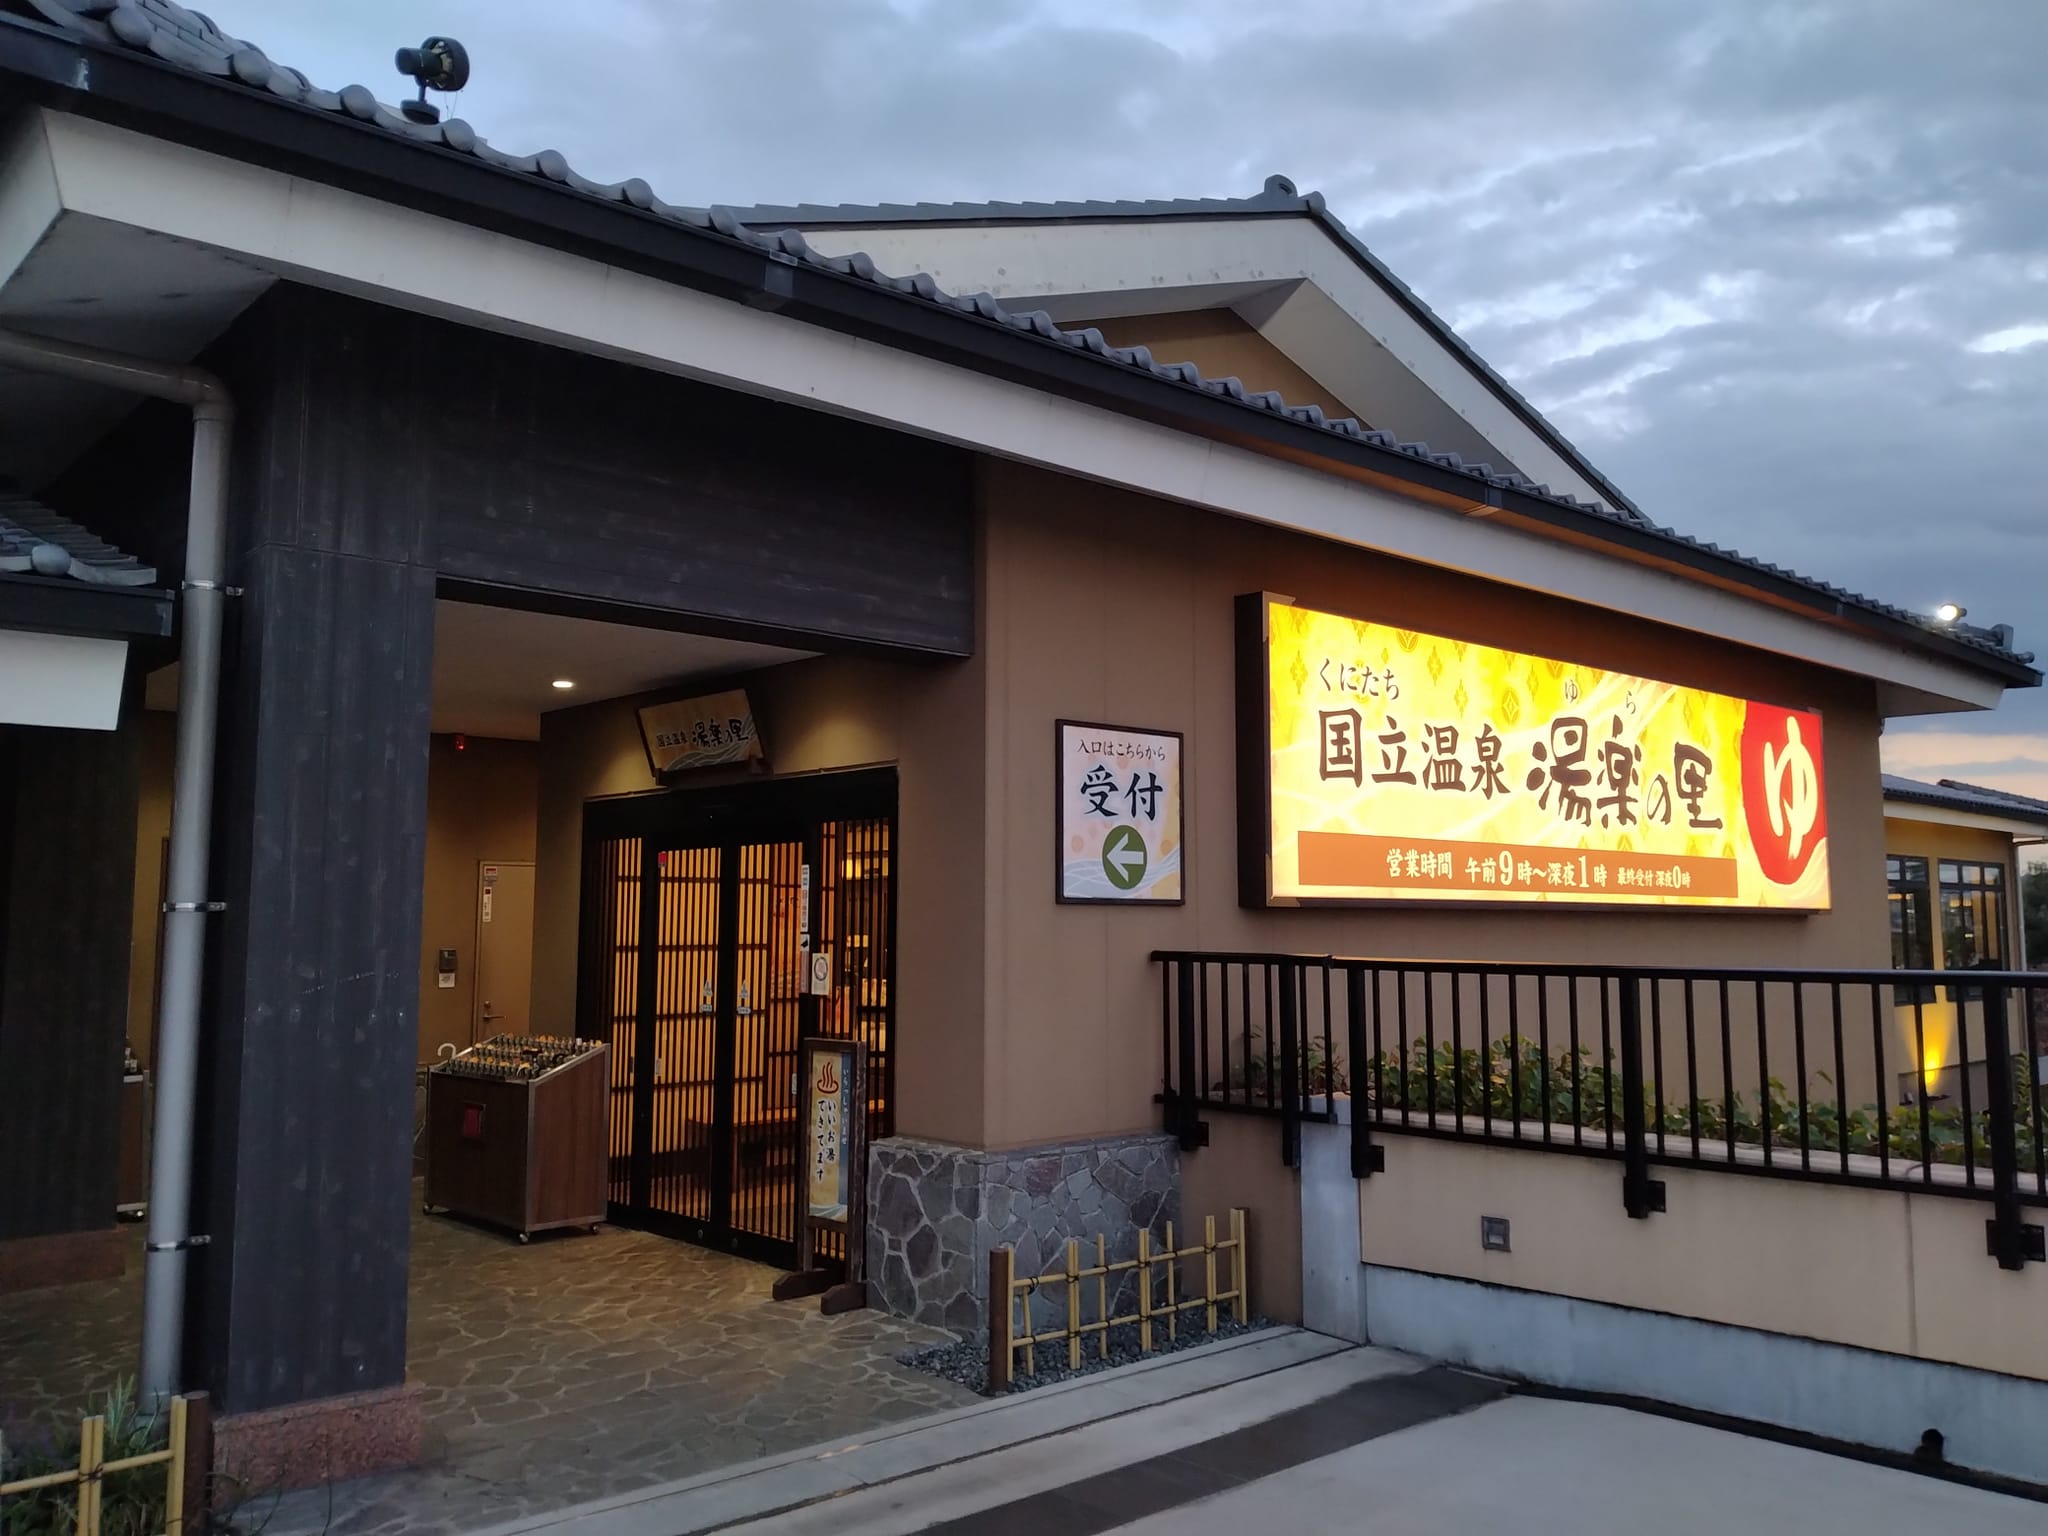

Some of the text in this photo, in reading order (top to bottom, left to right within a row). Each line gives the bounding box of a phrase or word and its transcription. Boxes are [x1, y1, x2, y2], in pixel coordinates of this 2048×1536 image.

[1318, 658, 1400, 700] くにたち
[1564, 679, 1579, 702] ゆ
[1625, 691, 1637, 715] ら
[1077, 739, 1166, 761] 入口はこちらから
[1318, 708, 1723, 829] 国立温泉 湯楽の里
[1080, 764, 1163, 821] 受付
[1764, 715, 1819, 860] ゆ
[1386, 848, 1453, 879] 営業時間
[826, 1101, 836, 1162] いいお湯
